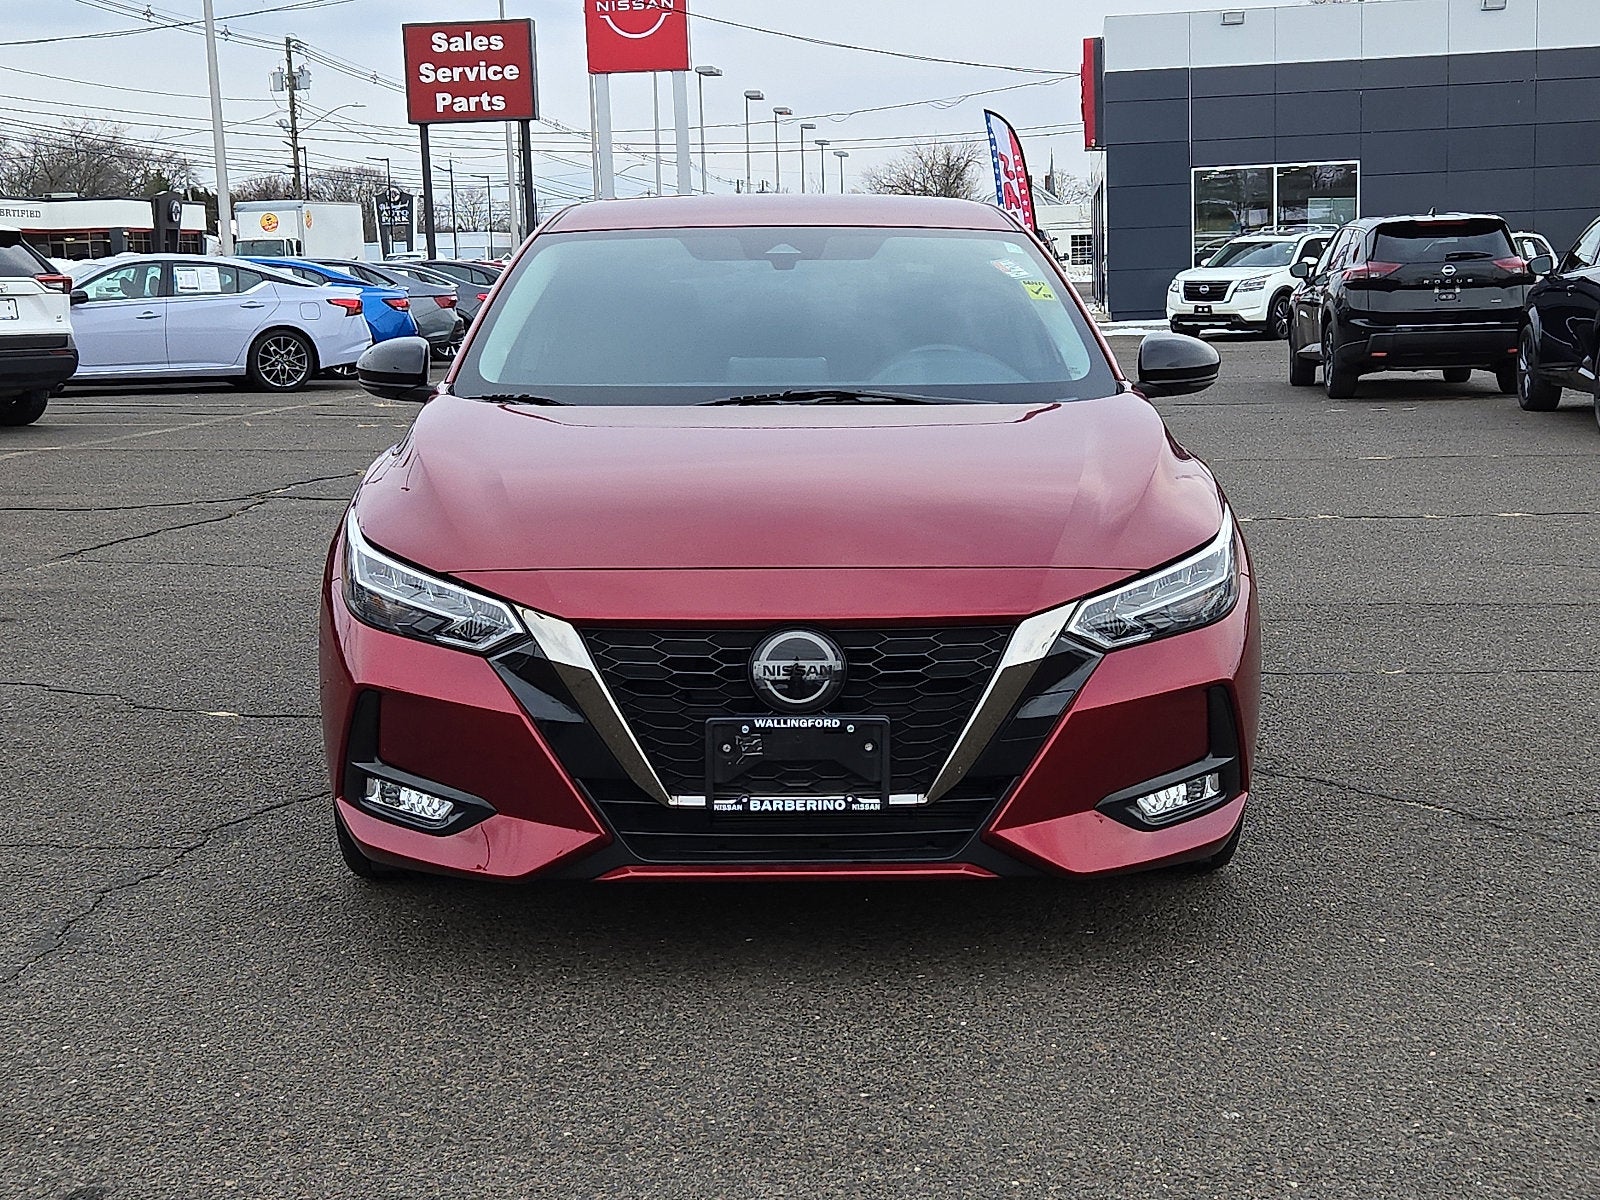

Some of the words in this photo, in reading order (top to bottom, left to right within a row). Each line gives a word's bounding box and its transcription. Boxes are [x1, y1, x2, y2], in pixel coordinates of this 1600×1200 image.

[596, 0, 674, 12] NISSAN
[431, 31, 505, 53] Sales
[418, 60, 520, 84] Service
[435, 91, 506, 113] Parts
[762, 664, 833, 677] NISSAN
[754, 719, 841, 728] WALLINGFORD
[713, 803, 743, 811] NISSAN
[749, 799, 846, 811] BARBERINO
[852, 803, 881, 811] NISSAN
